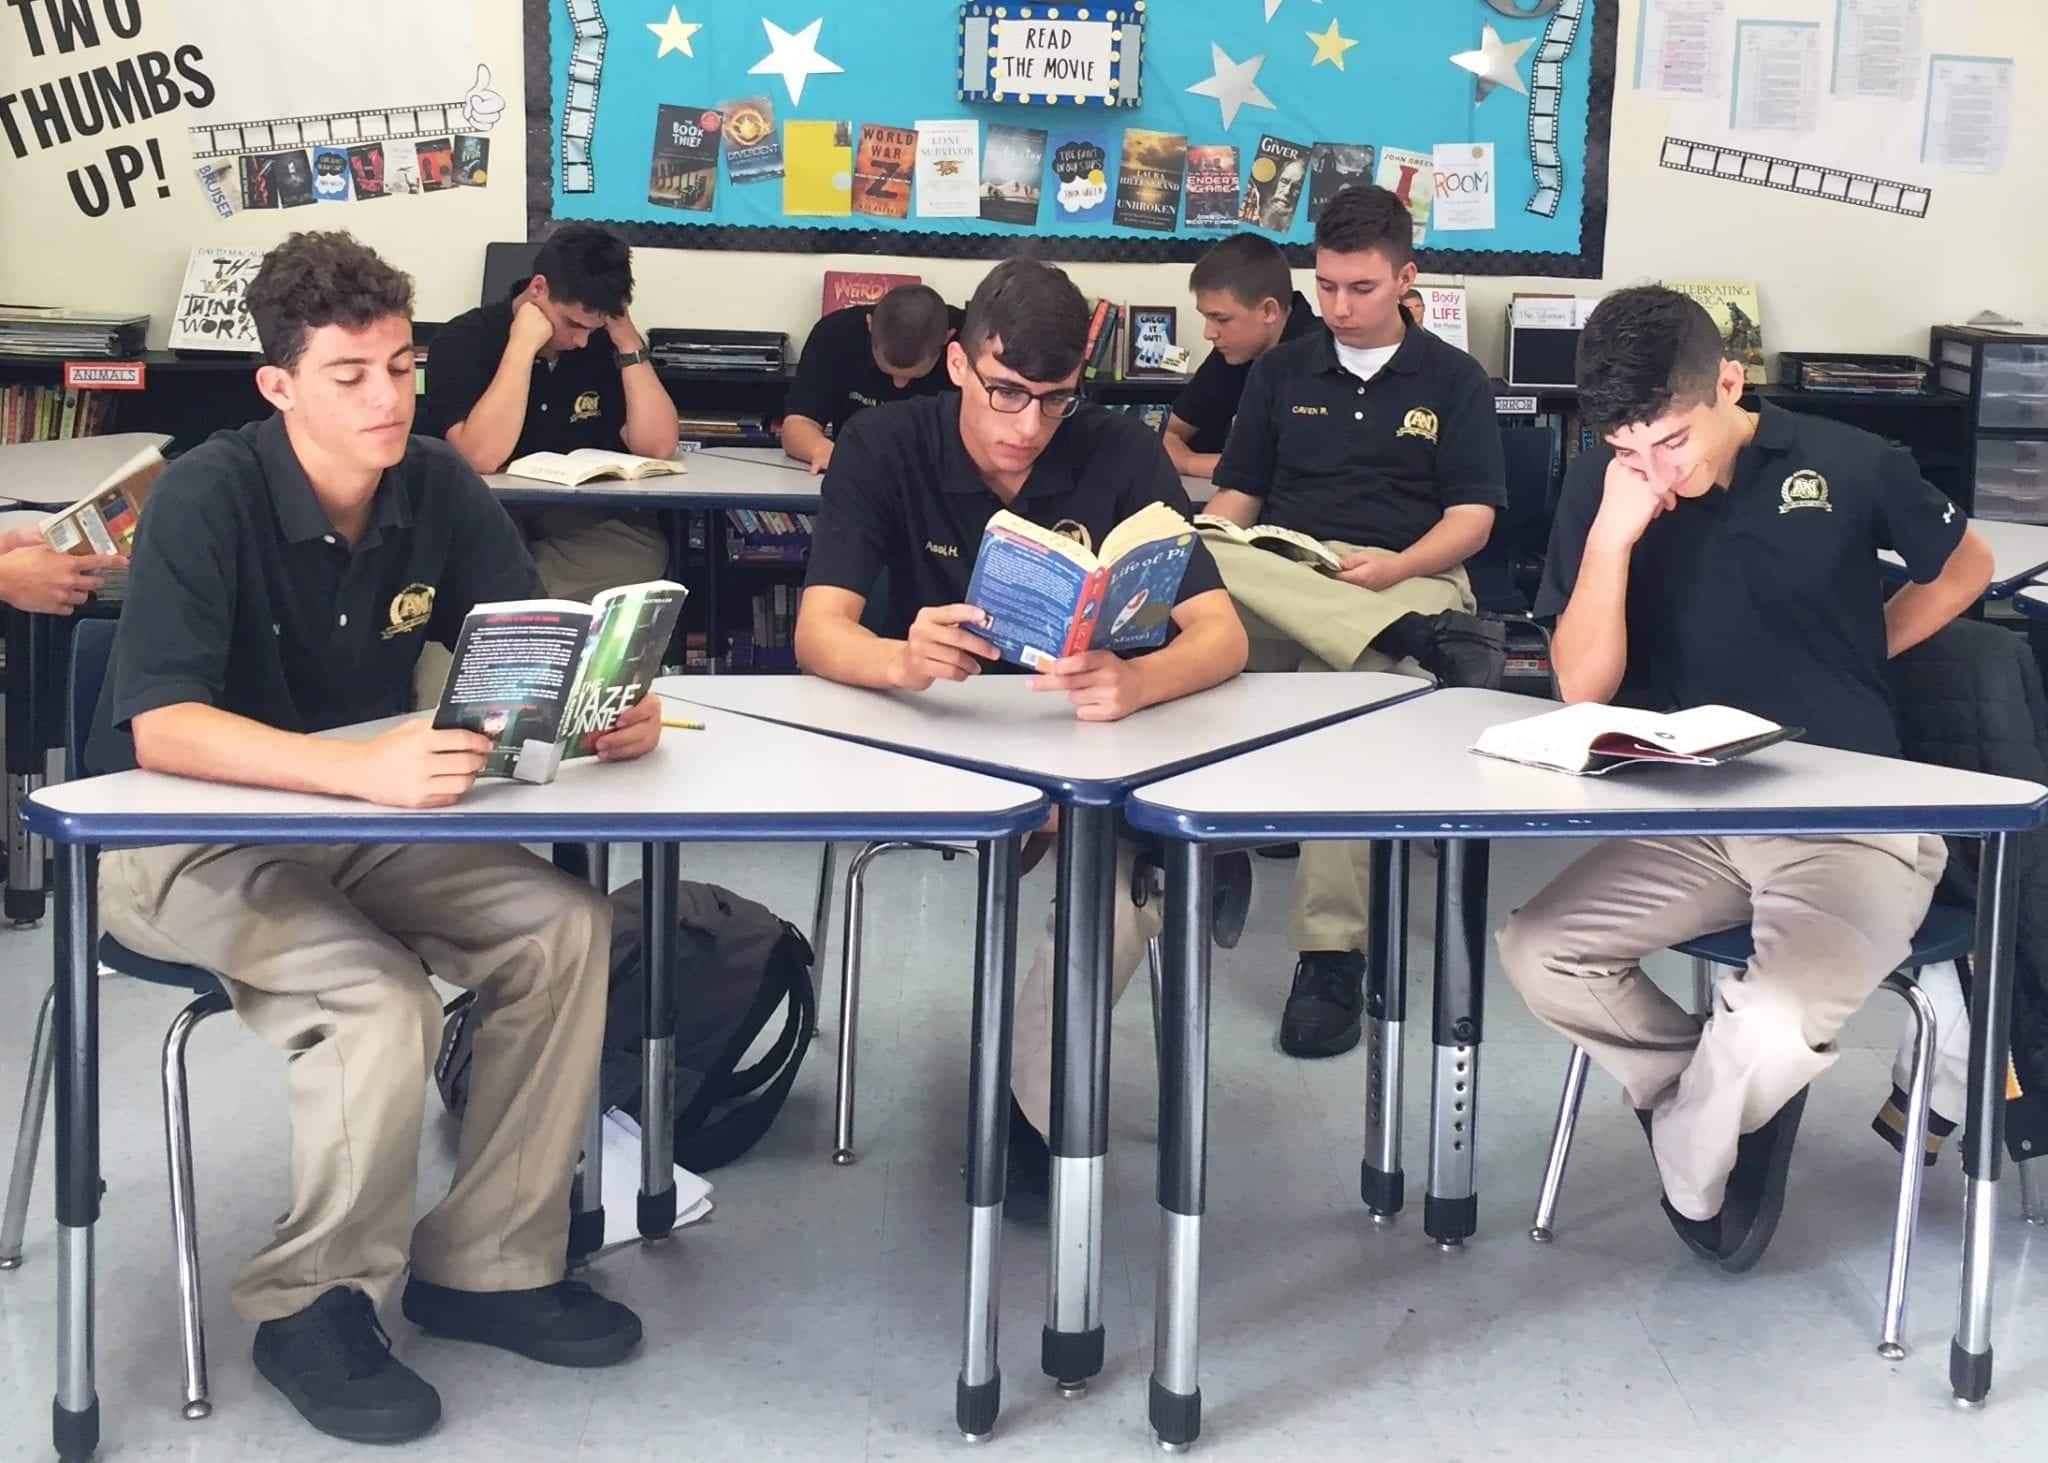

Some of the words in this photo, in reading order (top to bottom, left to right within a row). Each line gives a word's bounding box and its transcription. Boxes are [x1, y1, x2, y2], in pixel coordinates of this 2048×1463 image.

[7, 0, 142, 57] TWO
[1025, 27, 1072, 50] READ
[1002, 56, 1035, 79] THE
[1043, 58, 1095, 82] MOVIE
[0, 44, 216, 159] THUMBS
[672, 121, 705, 137] BOOK
[863, 127, 915, 146] WORLD
[672, 134, 702, 148] THIEF
[1261, 136, 1300, 160] GIVER
[871, 144, 901, 160] WAR
[1383, 152, 1407, 163] JOHN
[67, 138, 171, 218] UP!
[865, 159, 900, 200] Z
[1433, 171, 1489, 199] ROOM
[199, 164, 234, 219] BRUISER
[1116, 199, 1177, 215] UNBROKEN
[1431, 290, 1461, 305] Body
[1432, 307, 1462, 321] LIFE
[72, 368, 136, 382] ANIMALS
[1165, 546, 1186, 561] Pi
